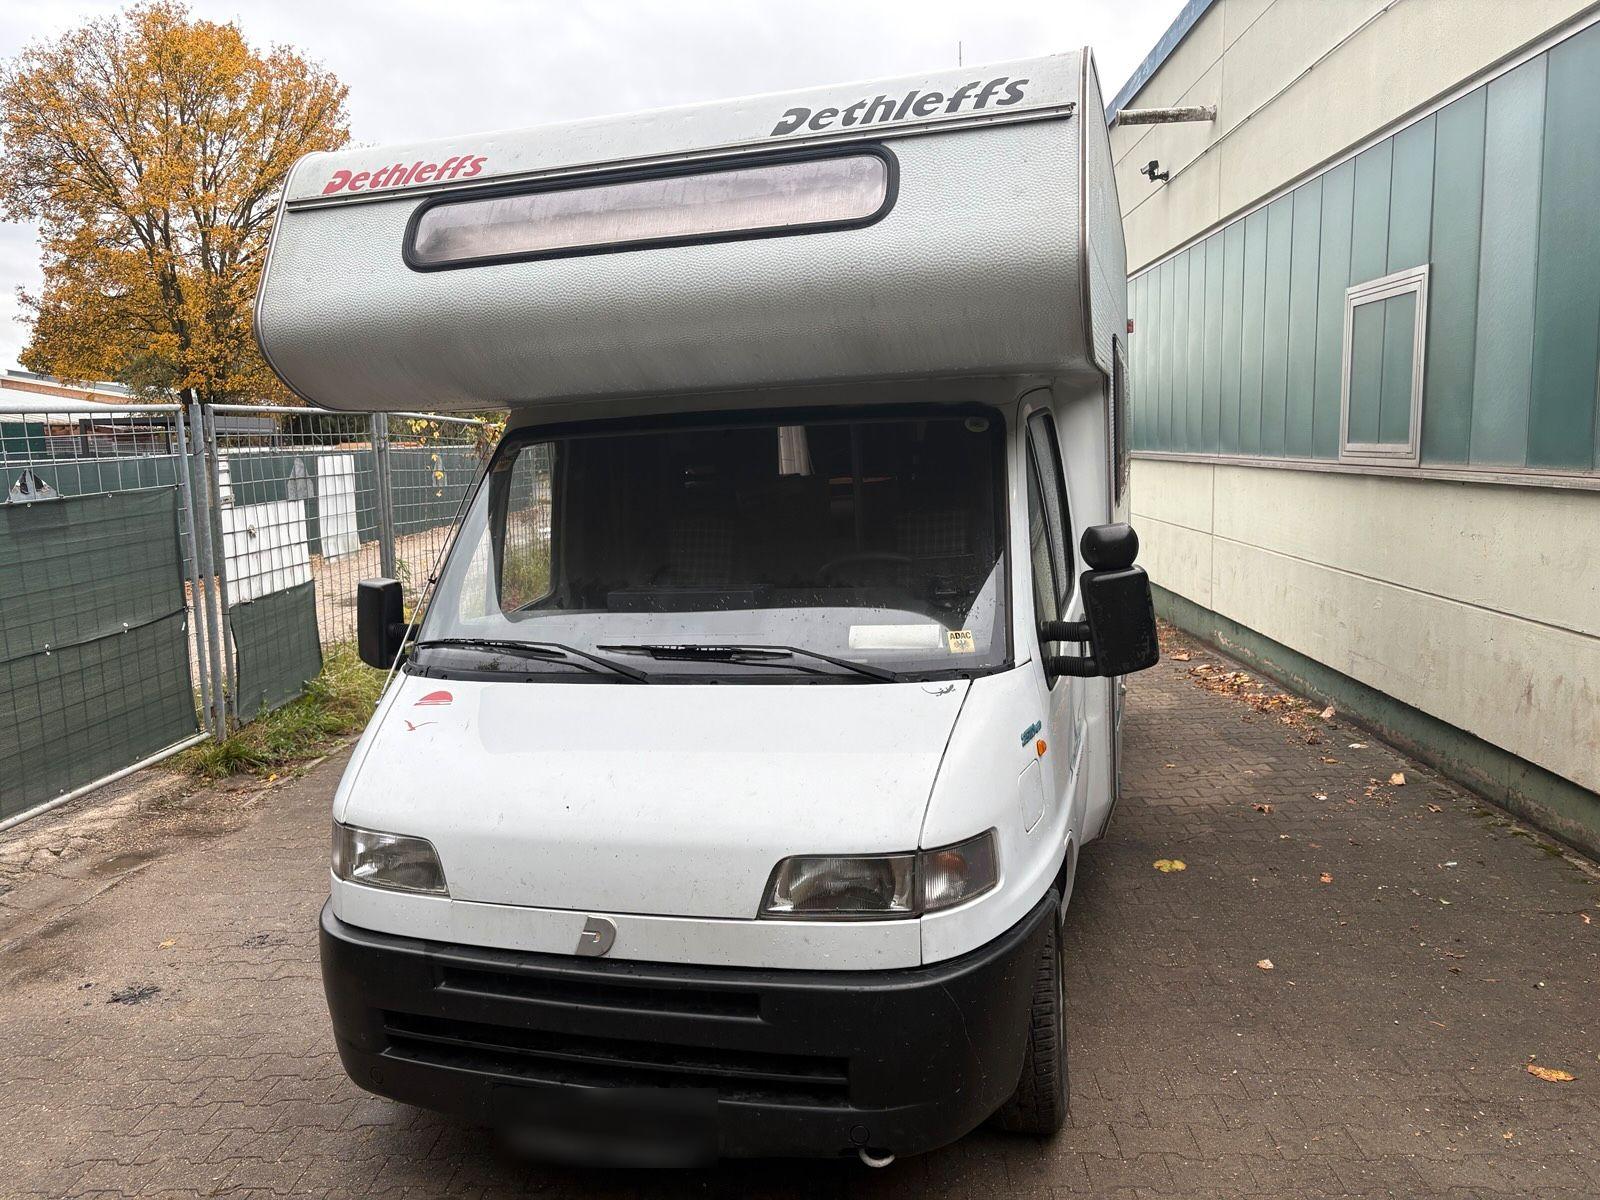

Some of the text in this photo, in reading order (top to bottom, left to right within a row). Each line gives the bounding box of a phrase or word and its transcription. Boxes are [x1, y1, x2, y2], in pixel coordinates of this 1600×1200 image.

[770, 76, 1029, 136] Dethleffs
[322, 155, 488, 194] Dethleffs
[950, 631, 971, 640] ADAC
